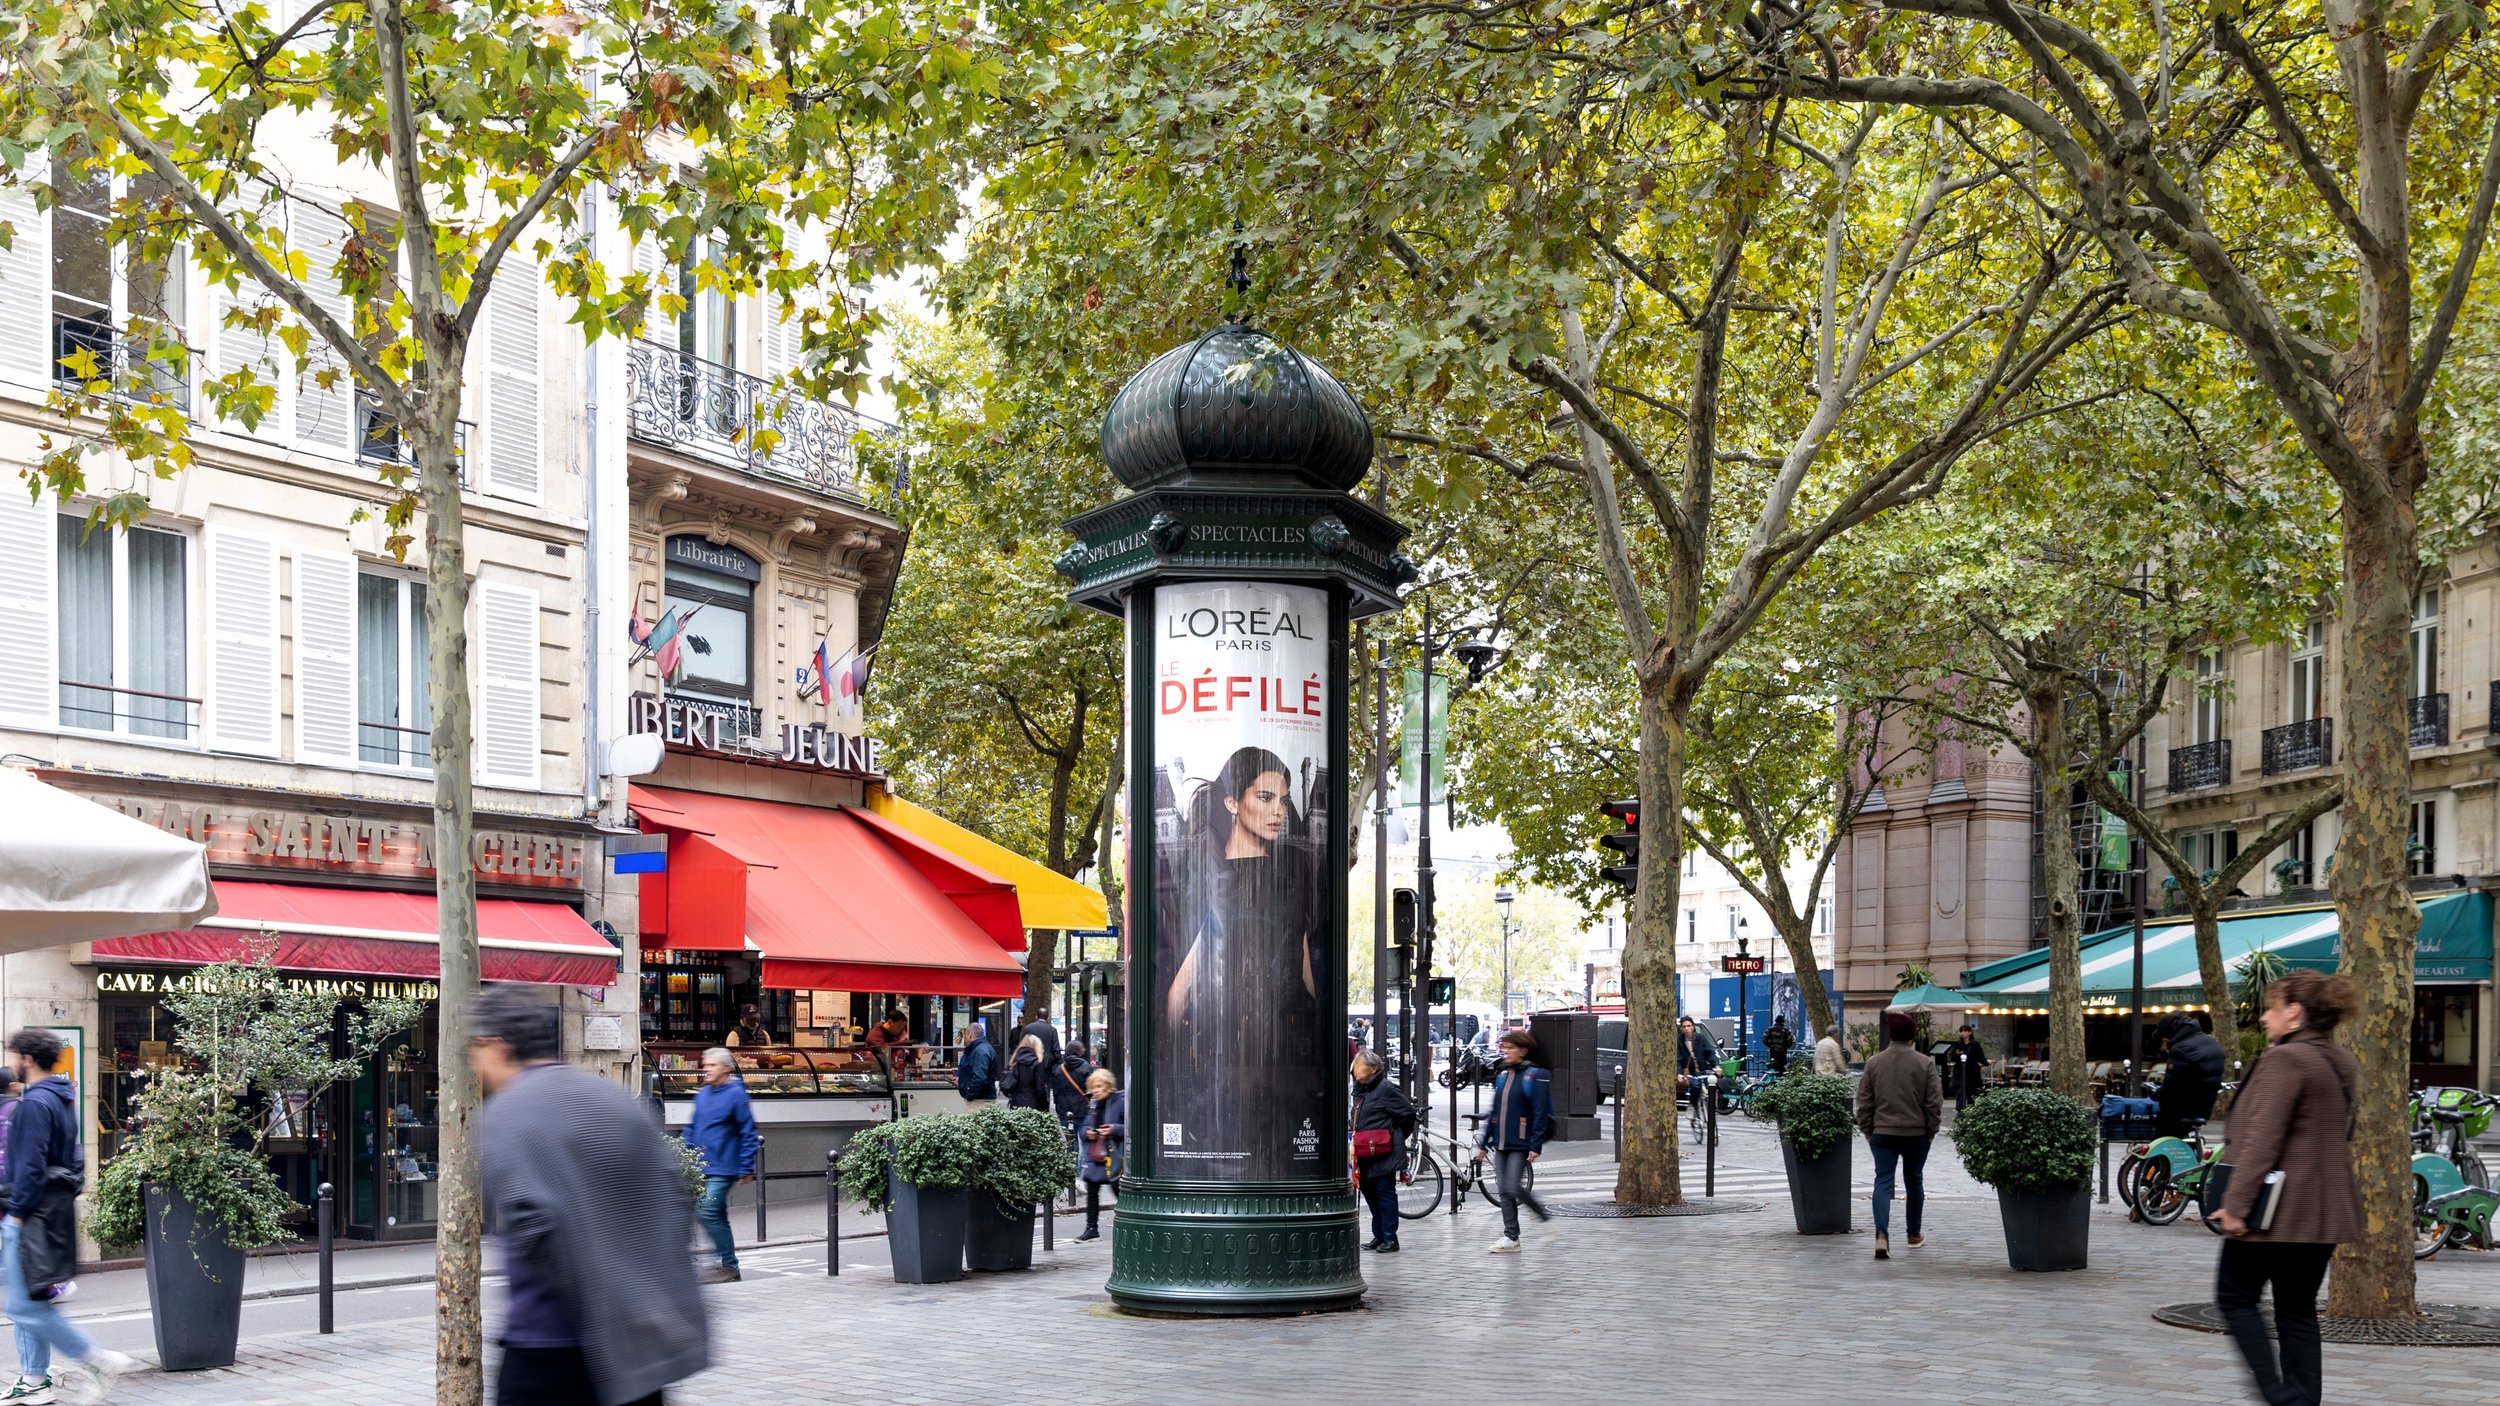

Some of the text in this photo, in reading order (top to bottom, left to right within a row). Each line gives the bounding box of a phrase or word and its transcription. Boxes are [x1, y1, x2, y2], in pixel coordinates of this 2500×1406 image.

[1087, 530, 1149, 564] SPECTACLES
[1190, 525, 1305, 544] SPECTACLES
[675, 538, 747, 573] Librairie
[1168, 606, 1314, 641] L'ORÉAL
[798, 669, 806, 684] 2
[1160, 660, 1180, 677] LE
[1160, 667, 1322, 717] DÉFILÉ
[628, 696, 885, 776] IBERT JEUNE
[250, 811, 391, 866] SAINT
[96, 972, 155, 993] CAVE
[158, 974, 175, 993] A
[2414, 966, 2465, 976] BREAKFAST
[1293, 1137, 1320, 1145] FASHION
